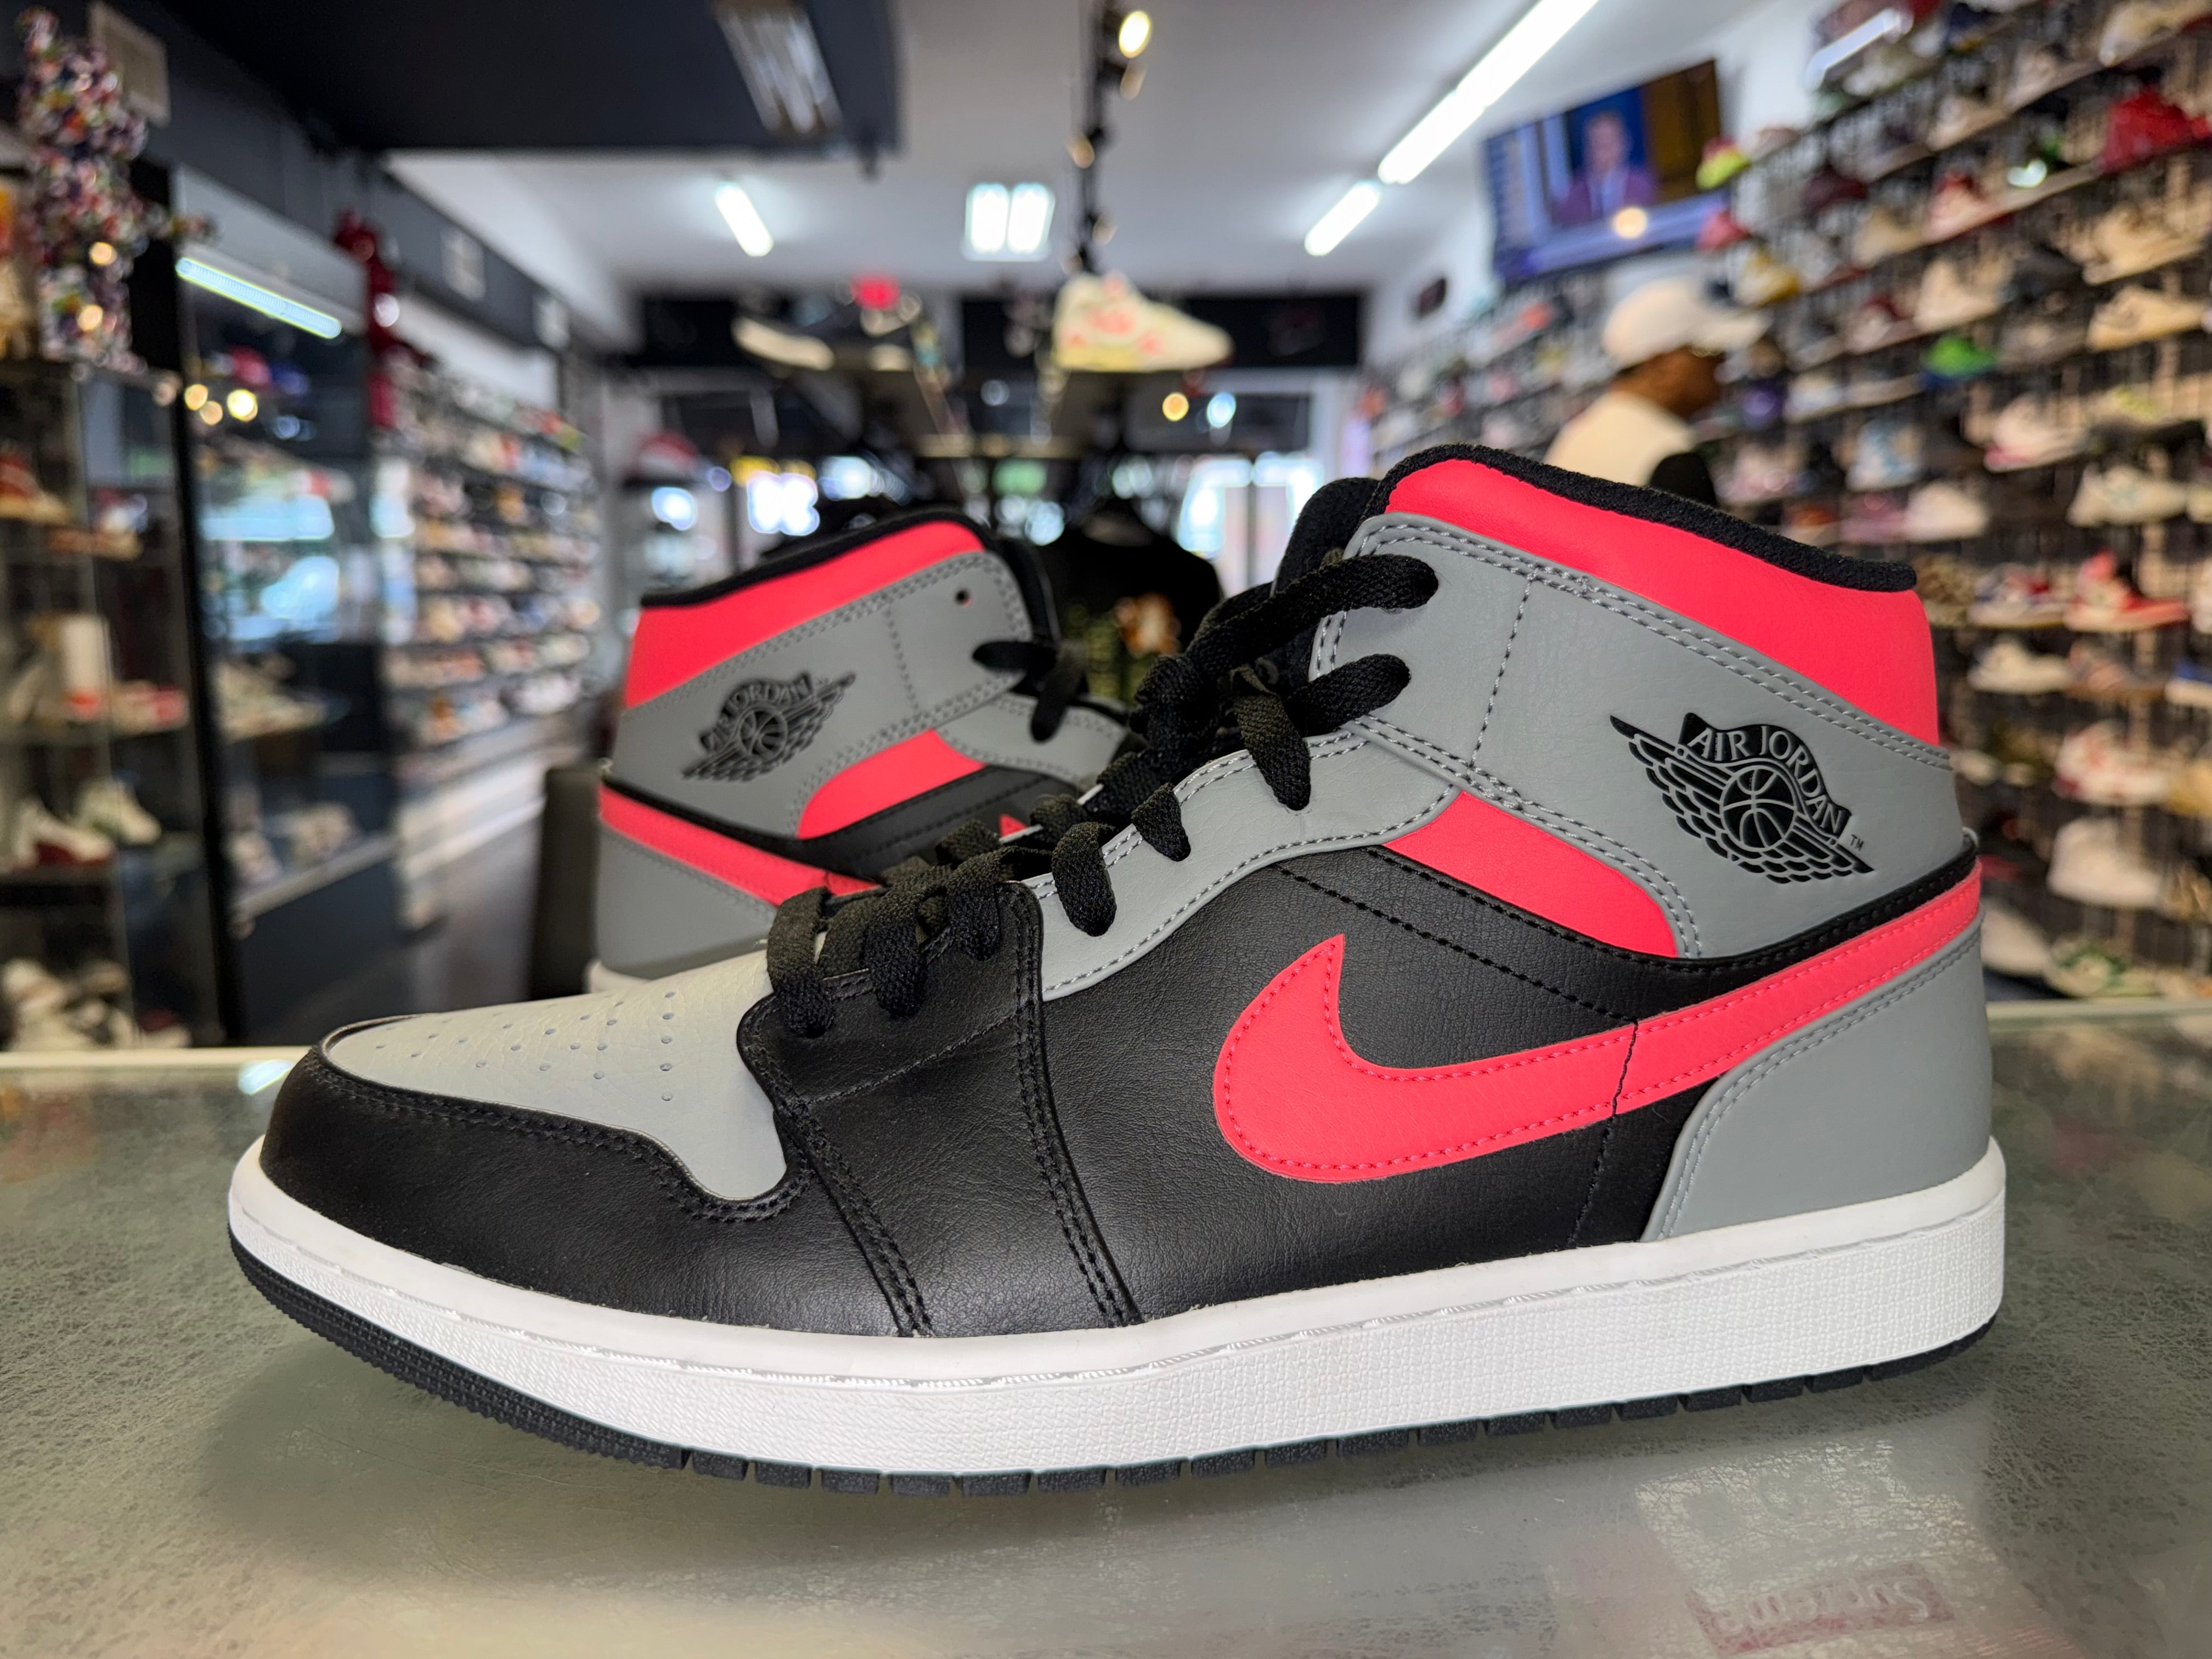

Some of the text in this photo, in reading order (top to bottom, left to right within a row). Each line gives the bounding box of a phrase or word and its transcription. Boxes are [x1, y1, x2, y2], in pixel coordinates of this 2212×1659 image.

[727, 678, 810, 712] JORDAN
[1688, 726, 1842, 833] AIR JORDAN
[1849, 834, 1864, 850] TM
